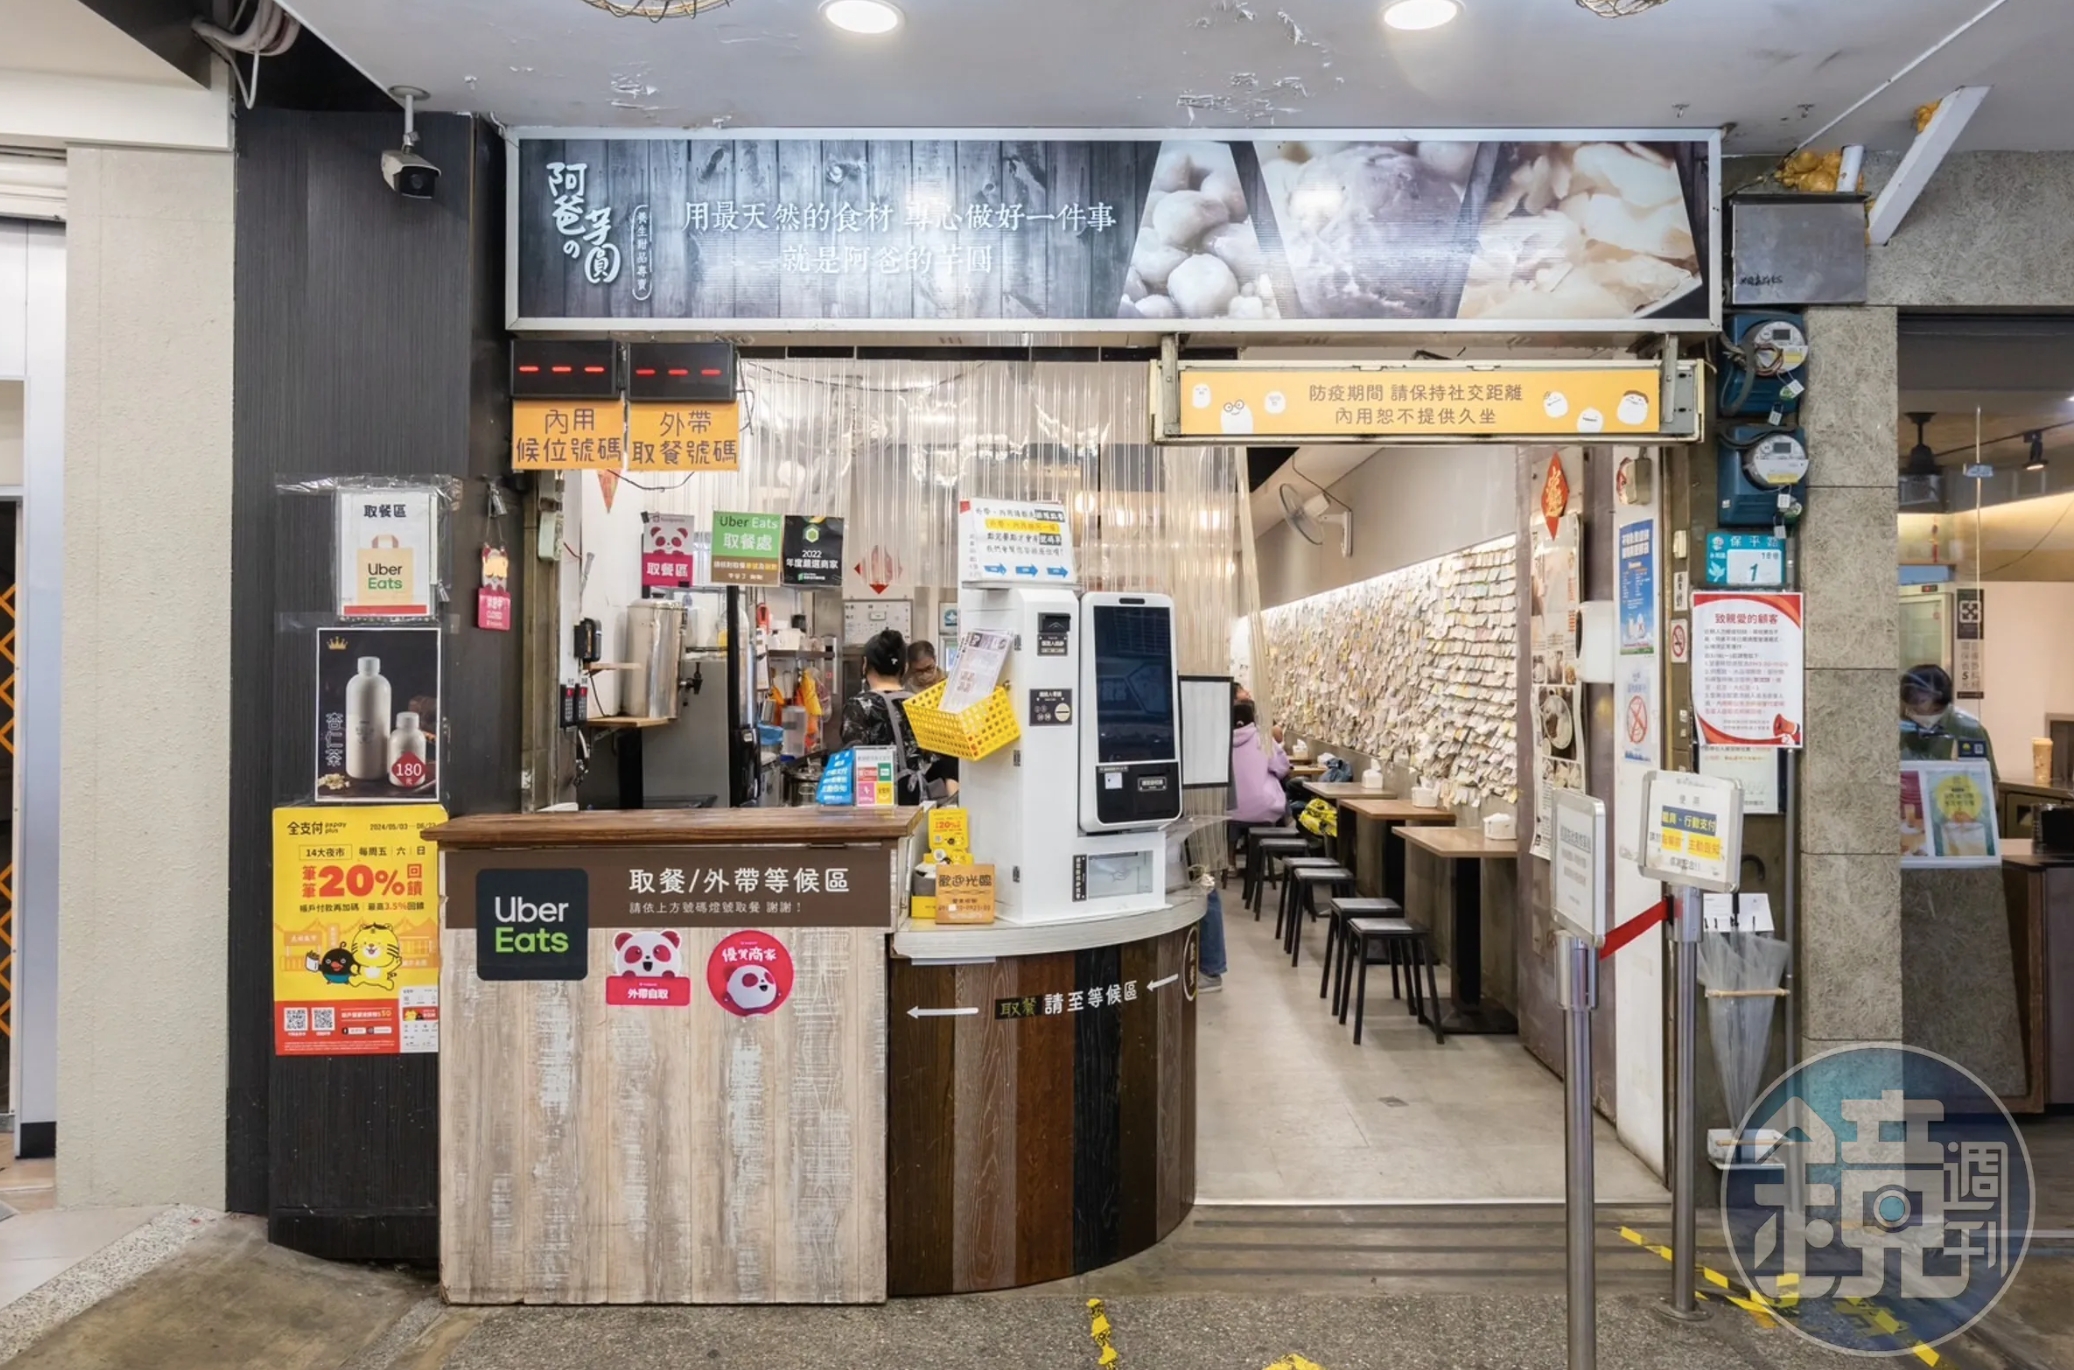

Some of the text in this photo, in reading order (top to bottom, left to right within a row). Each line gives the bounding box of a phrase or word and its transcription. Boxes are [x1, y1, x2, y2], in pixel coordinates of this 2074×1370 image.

[546, 162, 621, 284] 阿爸の 芋圓
[683, 201, 1117, 232] 用最天然的食材 專心做好一件事
[782, 247, 992, 275] 就是阿爸的芋圓
[1309, 384, 1523, 402] 防疫期間 請保持社交距離
[545, 409, 594, 434] 內用
[660, 411, 711, 437] 外帶
[1335, 407, 1496, 425] 內用恕不提供久坐
[516, 437, 621, 462] 候位號碼
[632, 440, 737, 465] 取餐號碼
[364, 504, 407, 518] 取餐區
[719, 516, 778, 529] Uber Eats
[723, 533, 772, 551] 取餐處
[802, 550, 823, 558] 2022
[368, 563, 403, 576] Uber
[646, 562, 688, 577] 取餐區
[1749, 563, 1758, 582] 1
[368, 577, 403, 590] Eats
[1715, 613, 1778, 624] 致親愛的顧客
[396, 763, 422, 777] 180
[287, 821, 323, 835] 全支付
[306, 847, 345, 857] 14大夜市
[396, 846, 406, 855] 六
[416, 846, 426, 855] 日
[318, 864, 405, 898] 20%
[407, 863, 422, 896] 回饋
[629, 868, 850, 894] 取餐/外帶等候區
[938, 874, 992, 887] 歡迎光臨
[495, 896, 569, 923] Uber
[629, 902, 760, 914] 請依上方號碼燈號取餐
[495, 927, 569, 953] Eats
[628, 988, 669, 1000] 外帶自取
[1001, 980, 1138, 1016] 取餐 請至等候區
